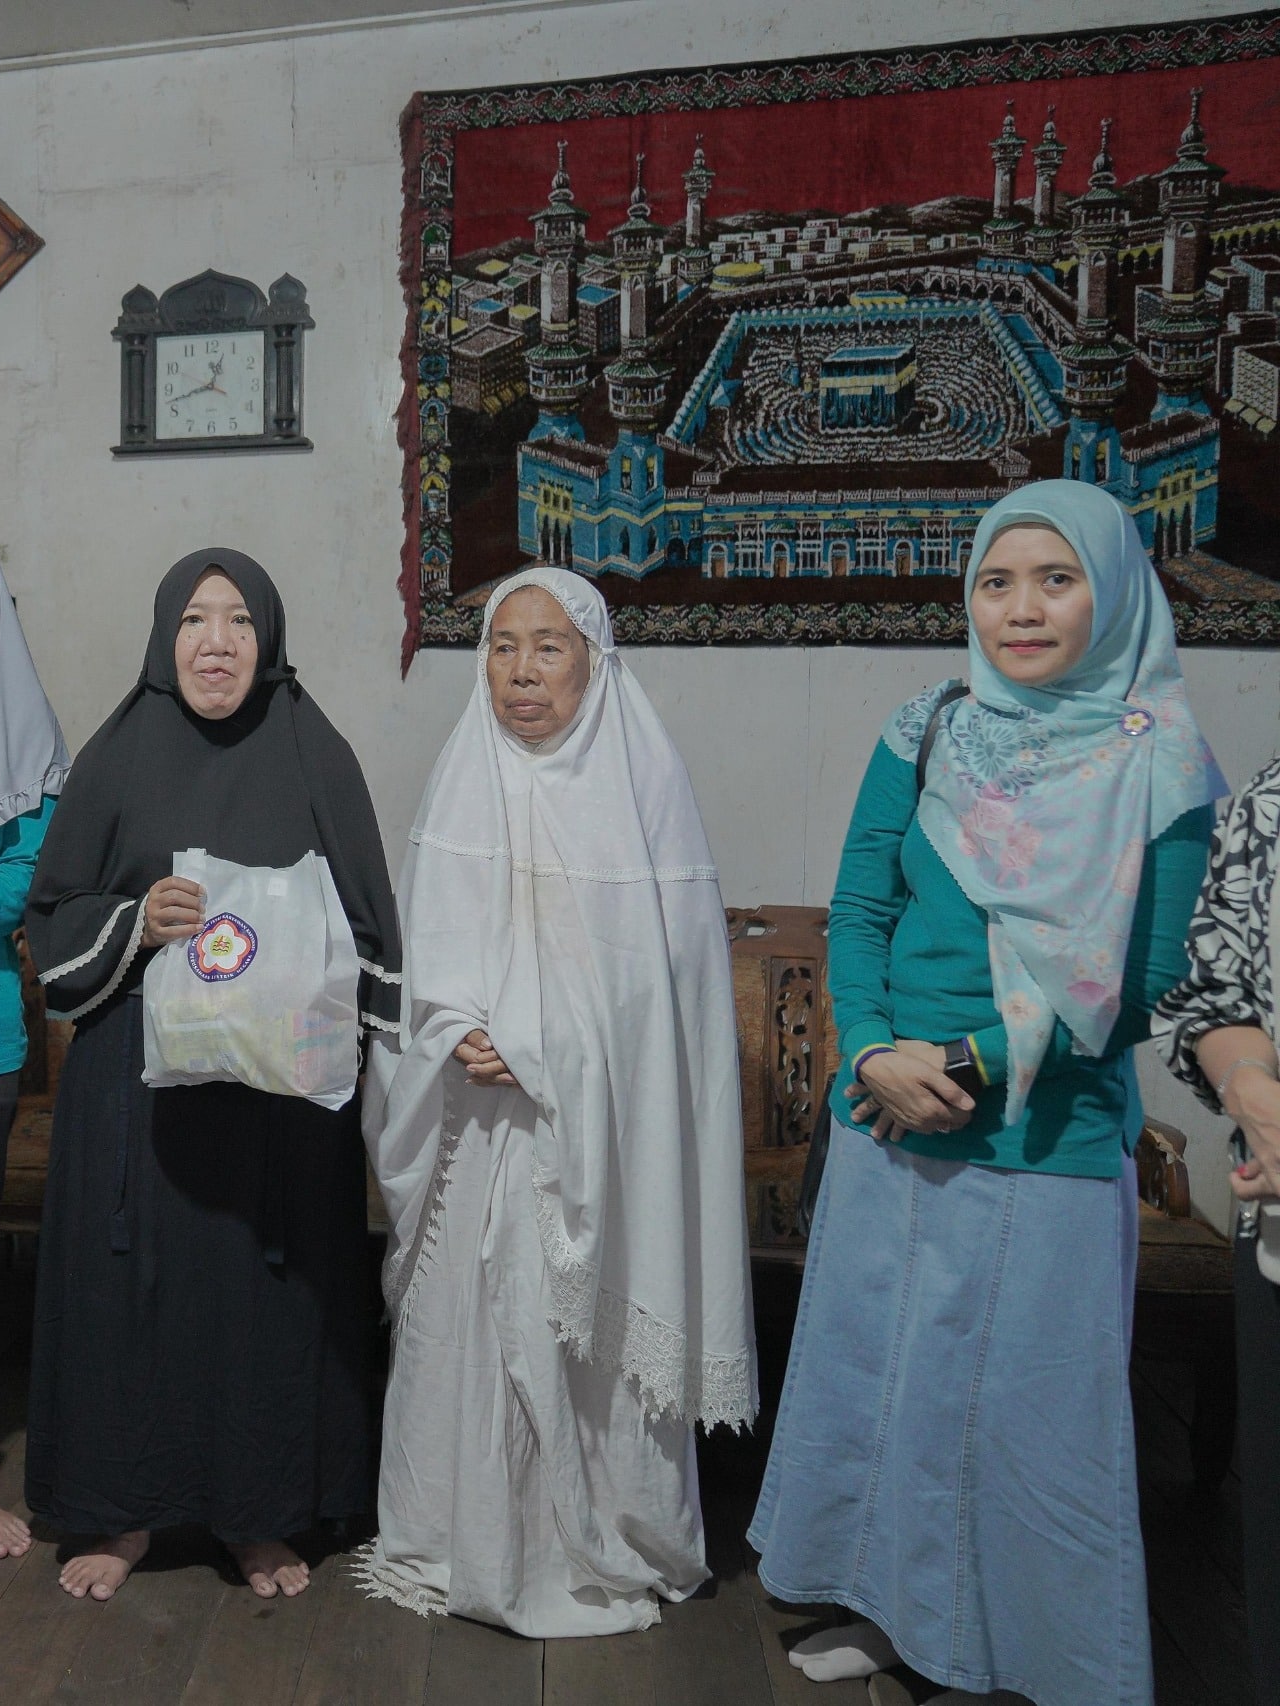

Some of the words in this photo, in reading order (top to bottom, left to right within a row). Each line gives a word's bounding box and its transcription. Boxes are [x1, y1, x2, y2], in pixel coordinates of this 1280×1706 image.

[184, 344, 195, 358] 11
[205, 340, 219, 354] 12
[231, 341, 237, 355] 1
[166, 362, 179, 376] 10
[246, 356, 256, 371] 2
[165, 383, 173, 396] 9
[251, 379, 260, 392] 3
[170, 404, 179, 417] 8
[245, 400, 254, 414] 4
[186, 419, 195, 433] 7
[207, 421, 216, 434] 6
[229, 417, 238, 431] 5
